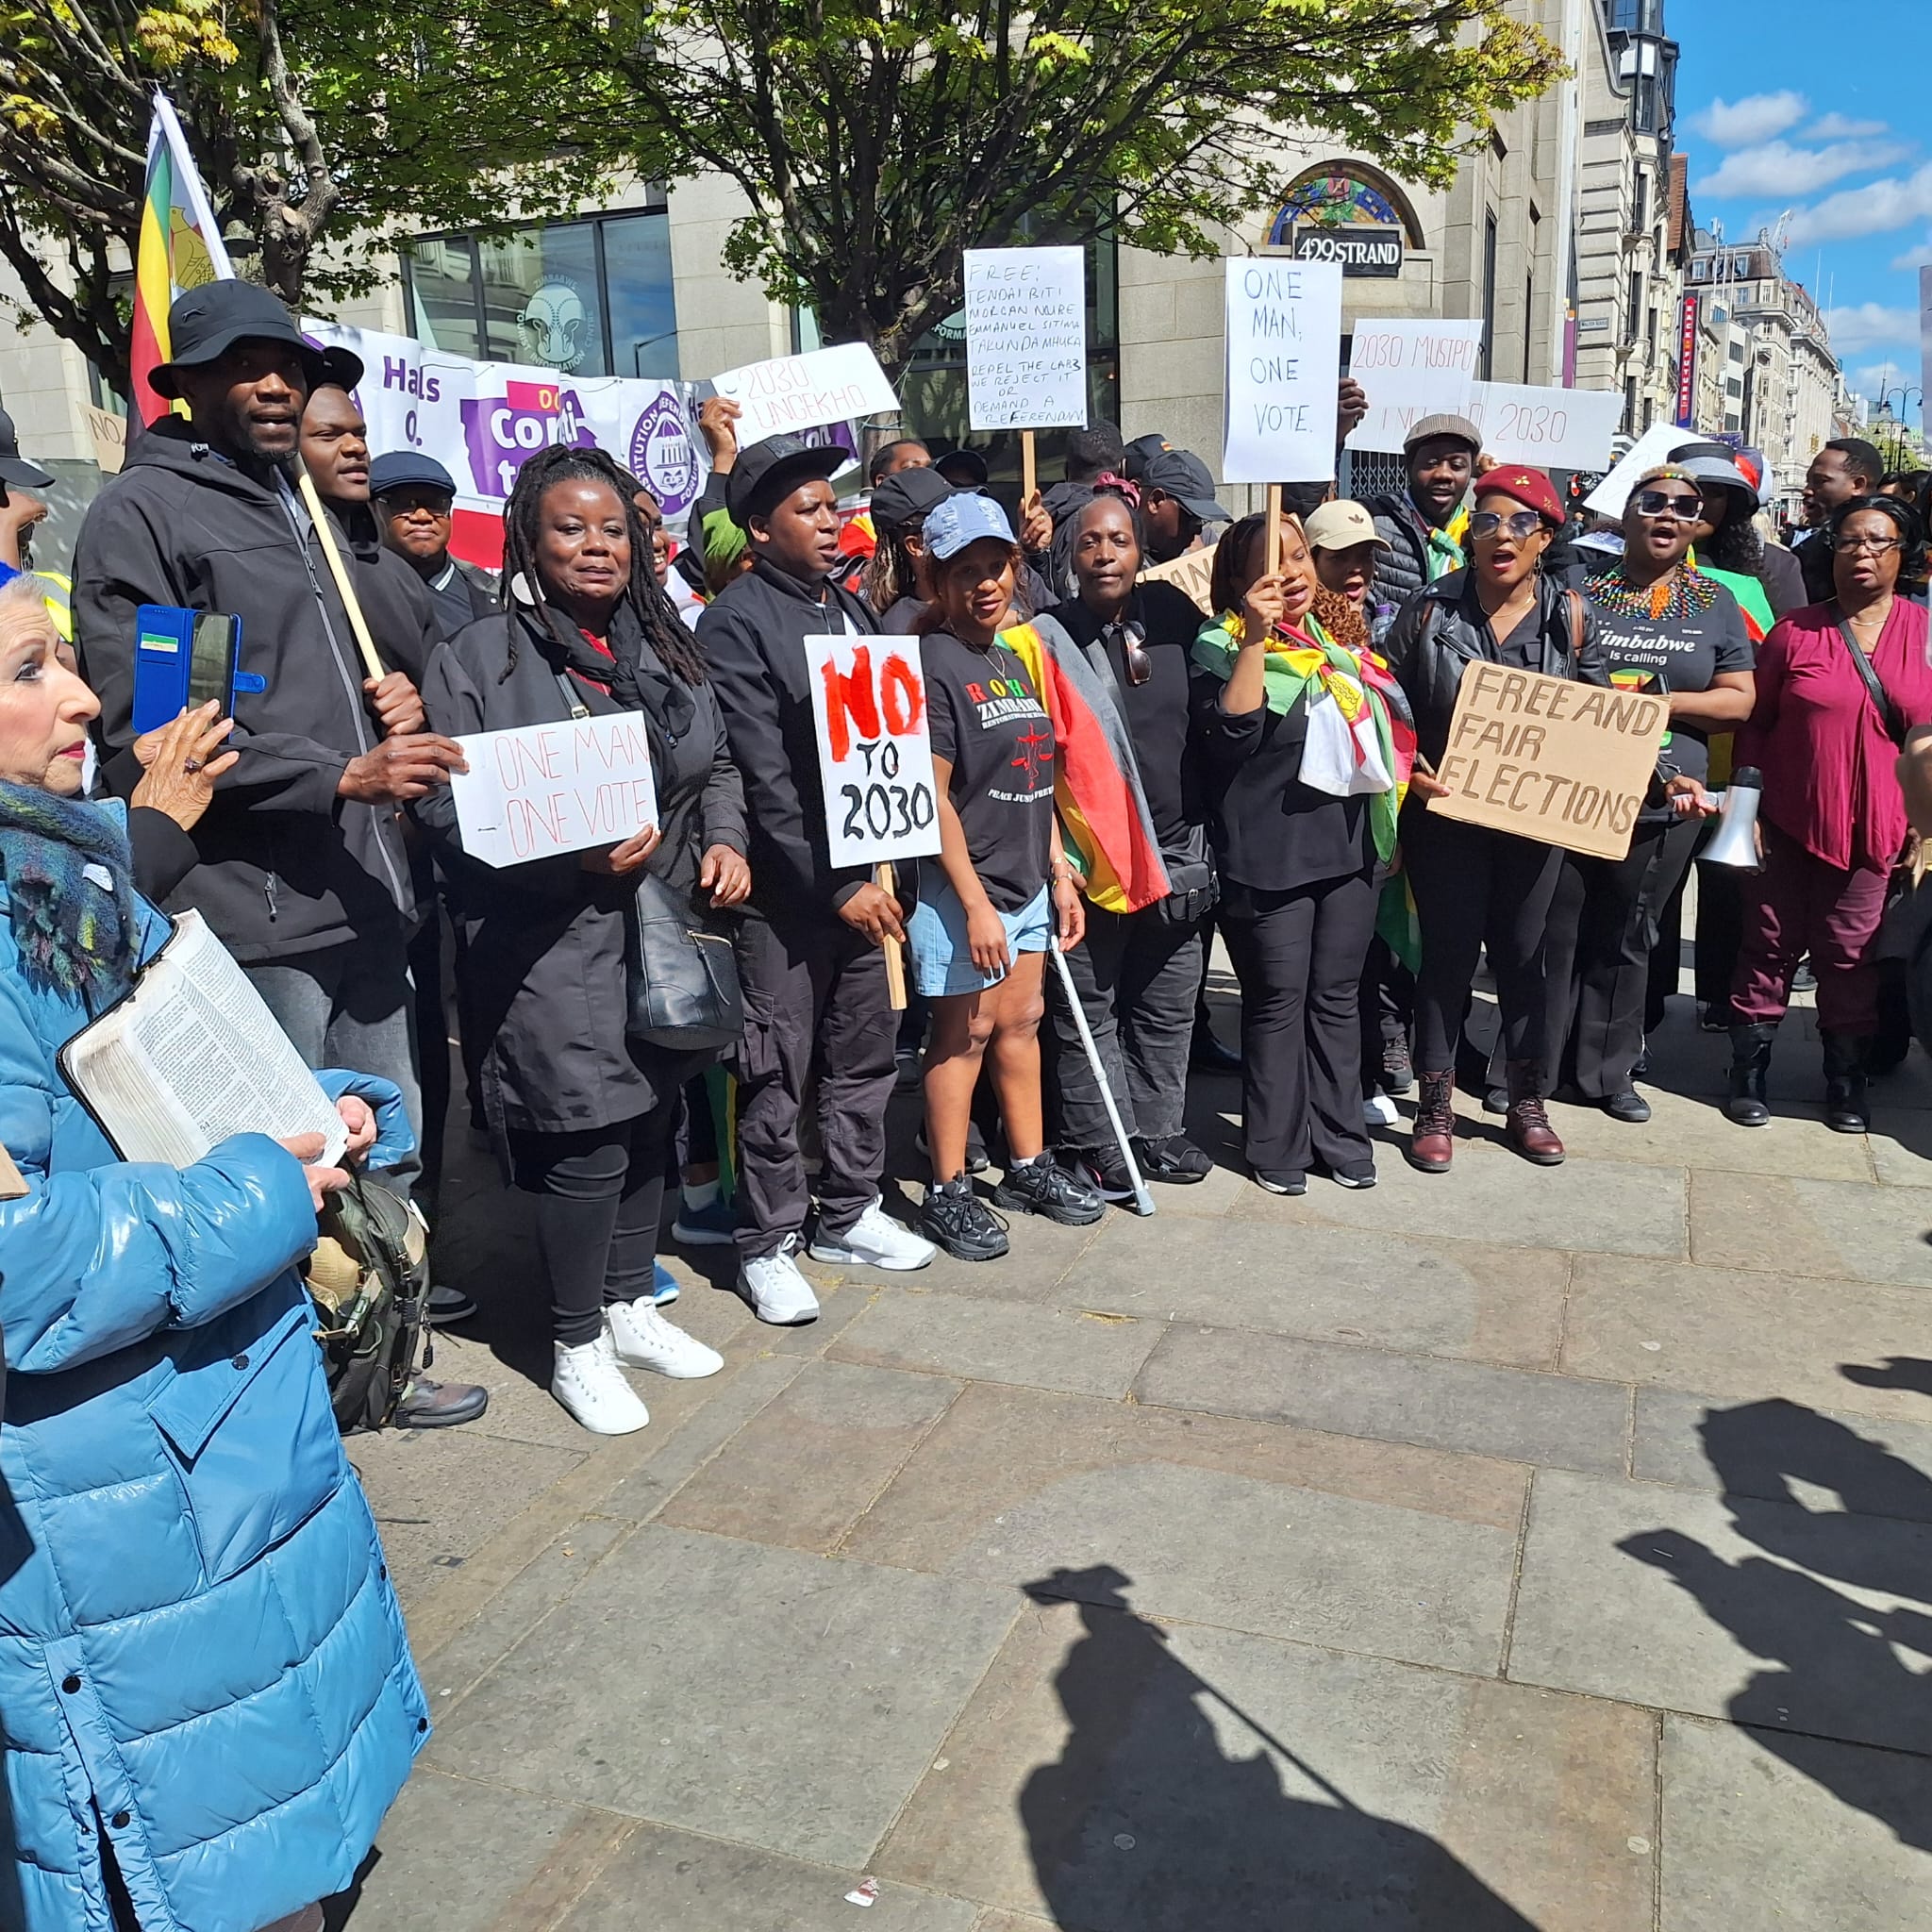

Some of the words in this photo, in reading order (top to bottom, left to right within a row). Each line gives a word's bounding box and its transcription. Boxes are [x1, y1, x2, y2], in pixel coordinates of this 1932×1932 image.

[1298, 238, 1335, 263] 429
[1335, 242, 1400, 265] STRAND
[967, 288, 1021, 305] TENDAI
[1244, 268, 1303, 301] ONE
[1019, 360, 1044, 372] THE
[1353, 334, 1404, 368] 2030
[739, 358, 809, 400] 2030
[994, 373, 1049, 386] REJECT
[1058, 373, 1073, 382] IT
[1250, 357, 1299, 384] ONE
[974, 397, 1029, 413] DEMAND
[1043, 396, 1055, 408] A
[999, 386, 1020, 397] OR
[1495, 403, 1567, 443] 2030
[1624, 652, 1668, 666] calling
[821, 644, 926, 763] NO
[1469, 666, 1575, 720] FREE
[1571, 691, 1660, 737] AND
[1452, 712, 1547, 761] FAIR
[495, 731, 562, 791] ONE
[574, 722, 649, 774] MAN
[857, 740, 899, 779] TO
[841, 782, 934, 840] 2030
[1441, 755, 1641, 835] ELECTIONS
[507, 792, 572, 858] ONE
[574, 778, 650, 837] VOTE
